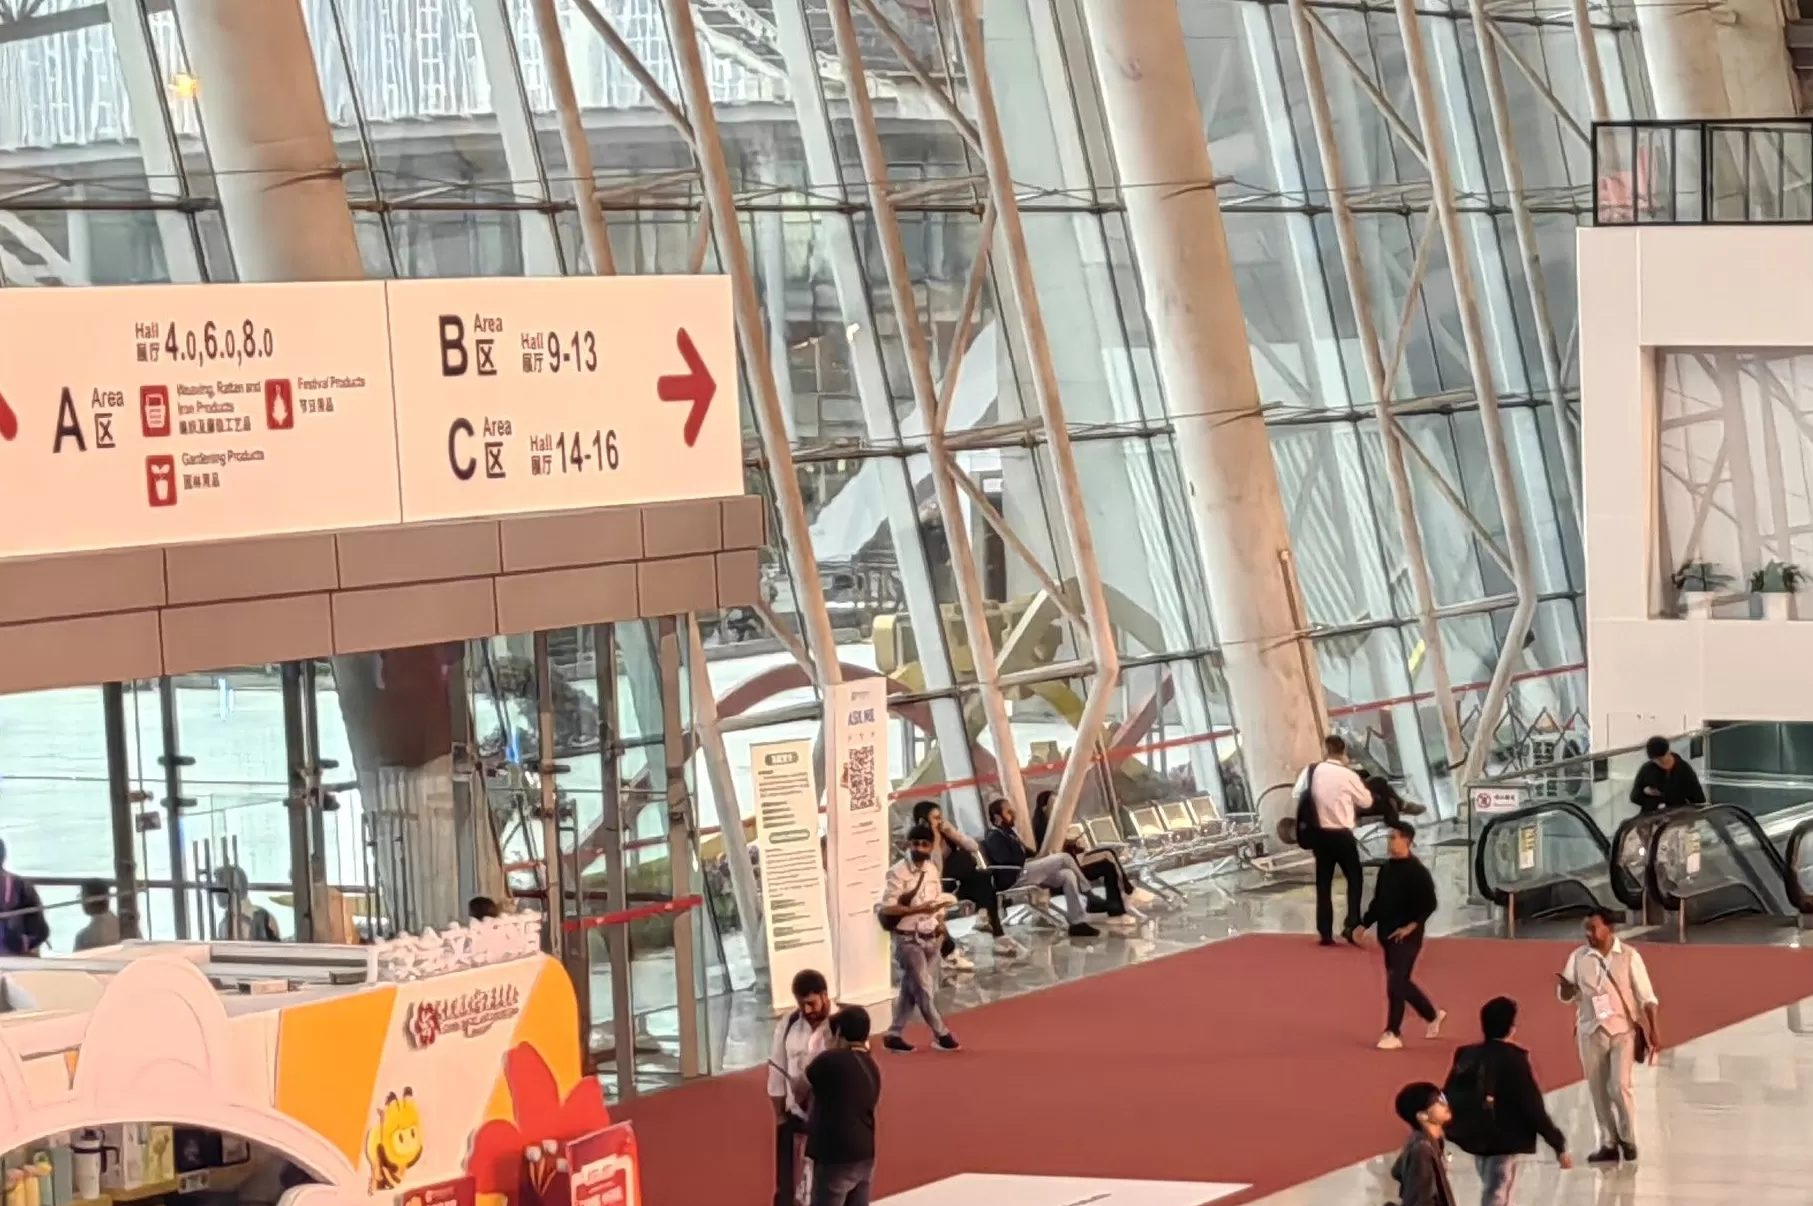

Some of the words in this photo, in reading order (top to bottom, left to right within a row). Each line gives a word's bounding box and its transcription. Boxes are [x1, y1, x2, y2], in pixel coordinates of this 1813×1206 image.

[135, 322, 159, 339] Hall
[474, 313, 503, 332] Area
[521, 332, 544, 350] Hall
[165, 319, 273, 368] 4.0,6.0,8.0
[439, 314, 468, 377] B
[475, 339, 497, 375] 区
[547, 330, 598, 373] 9-13
[91, 387, 125, 409] Area
[52, 386, 87, 453] A
[95, 412, 116, 449] 区
[483, 416, 512, 437] Area
[448, 417, 477, 481] C
[484, 441, 506, 479] 区
[530, 434, 552, 452] Hall
[556, 429, 619, 474] 14-16
